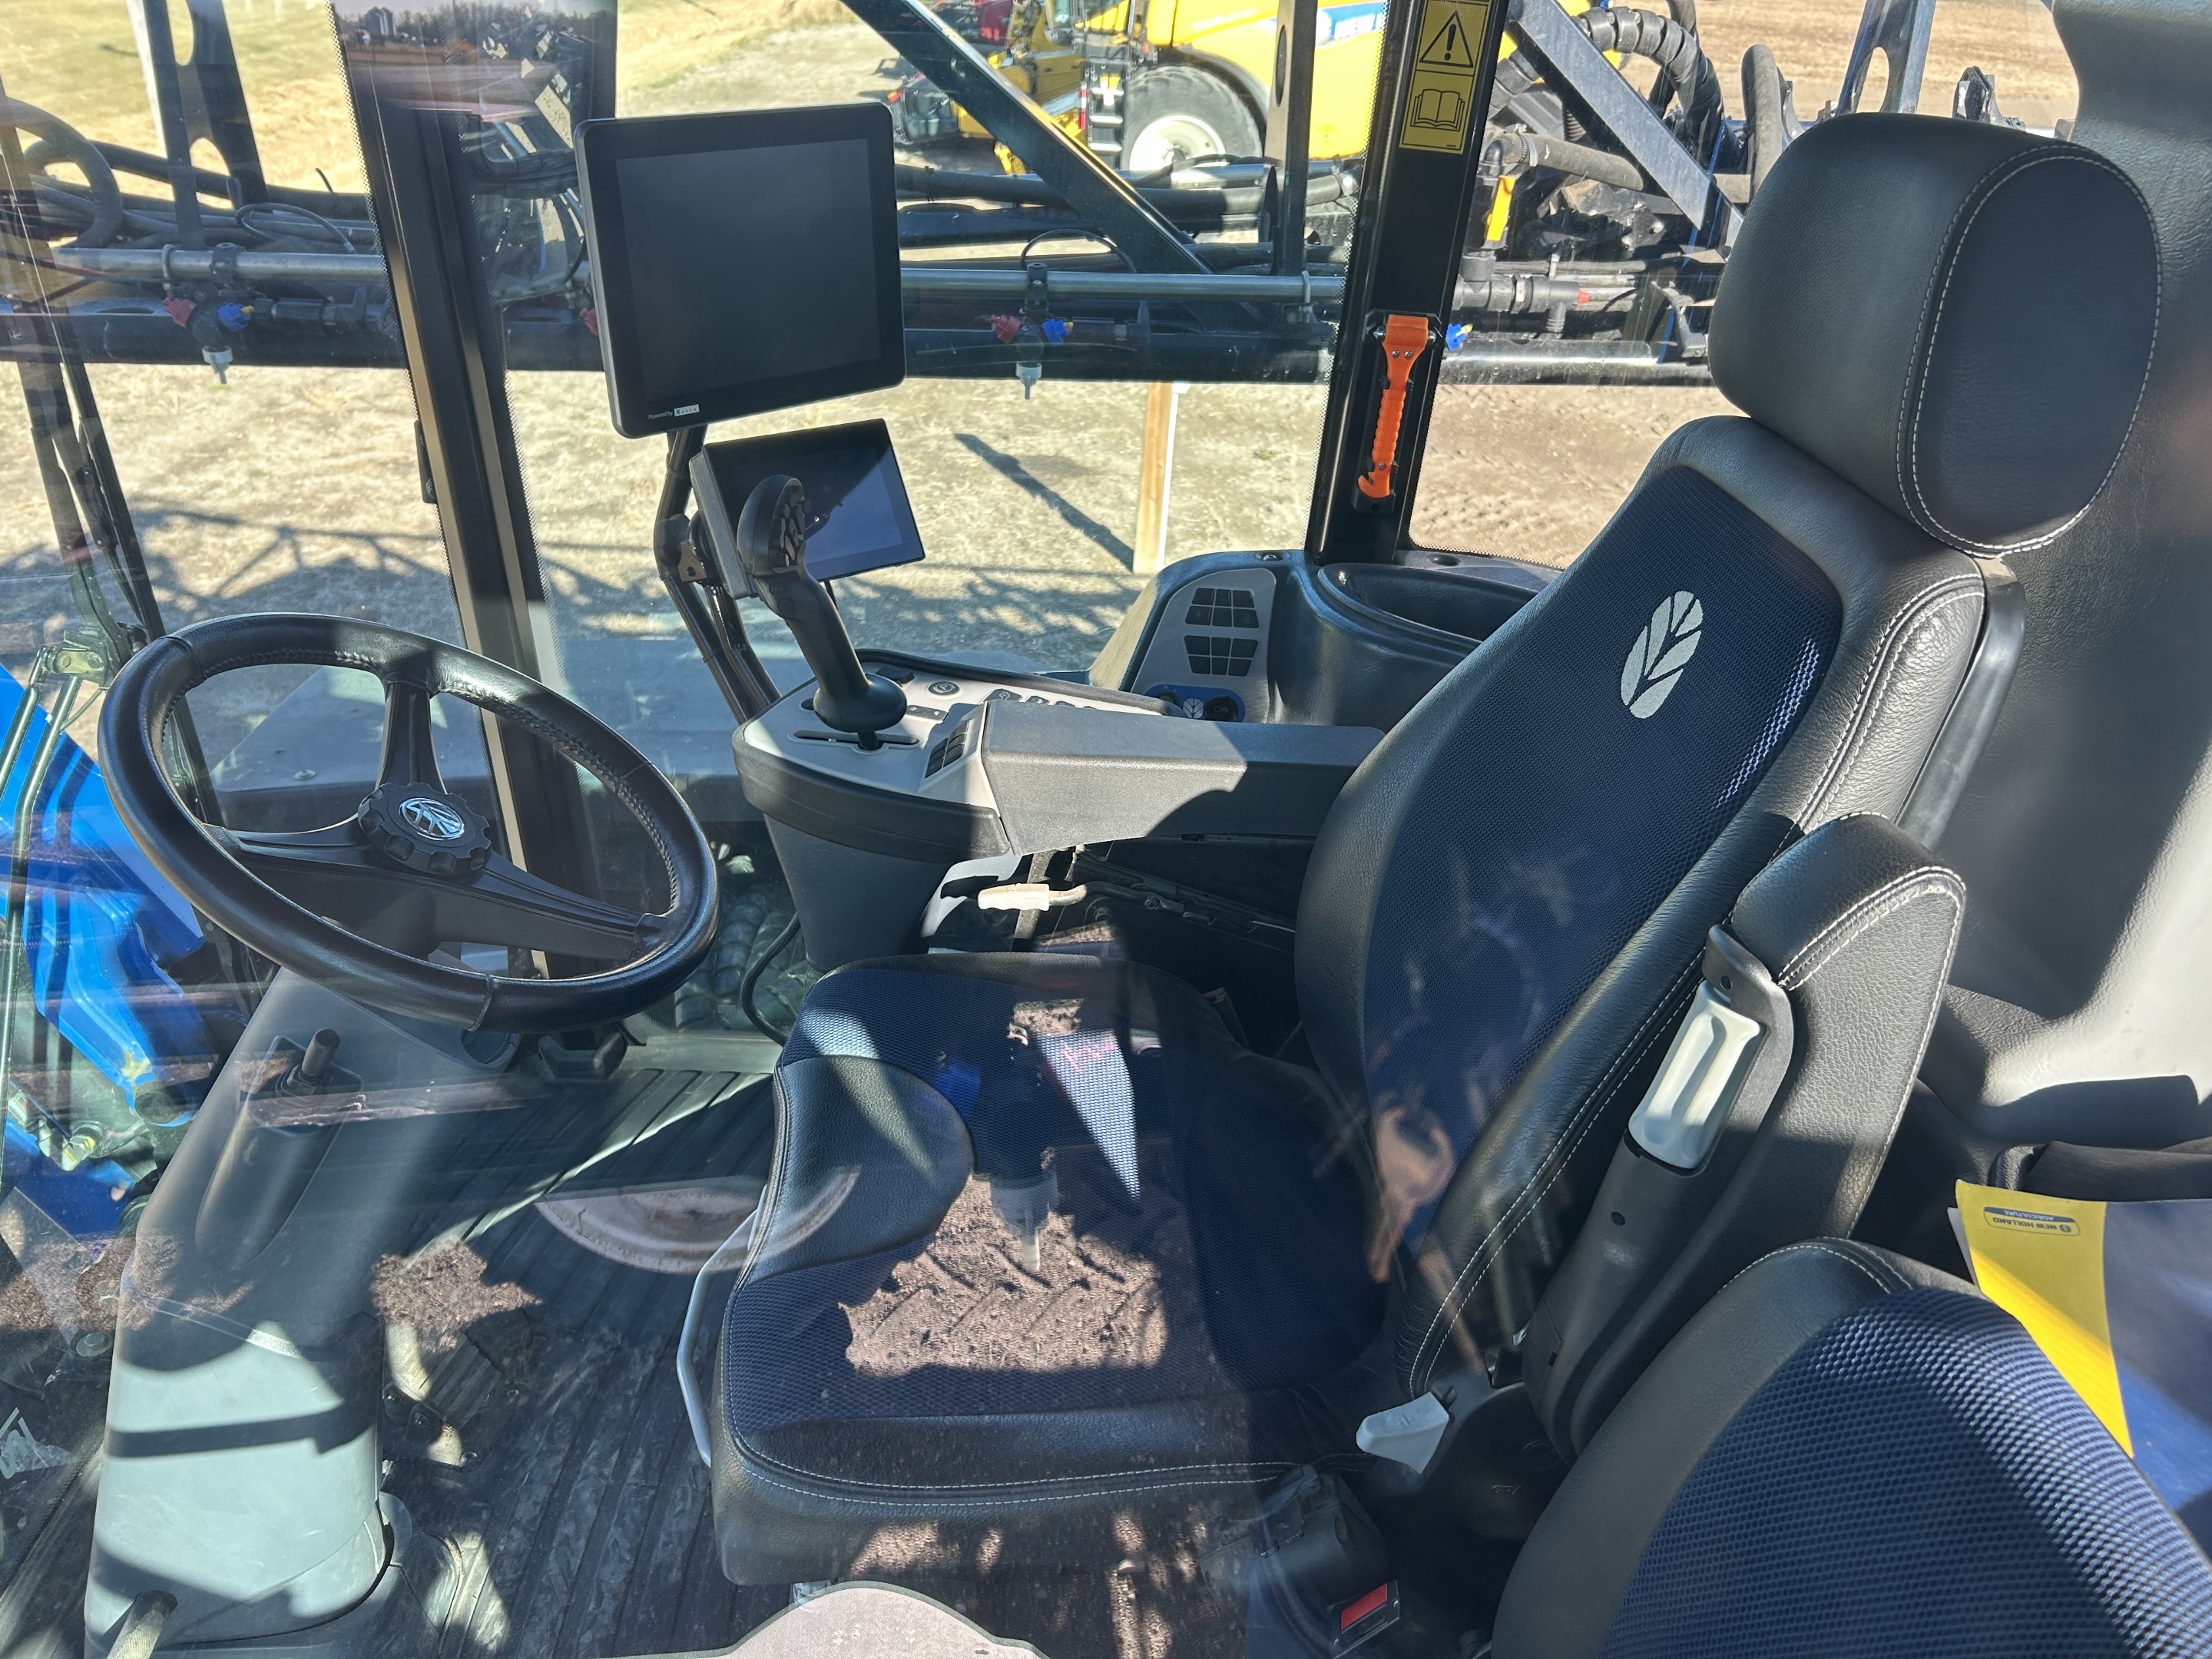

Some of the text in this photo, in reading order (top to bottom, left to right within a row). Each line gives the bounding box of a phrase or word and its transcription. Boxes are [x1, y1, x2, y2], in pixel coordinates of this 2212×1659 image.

[648, 412, 667, 420] Powered
[2004, 1210, 2054, 1221] AGRICULTURE
[1992, 1217, 2035, 1228] HOLLAND
